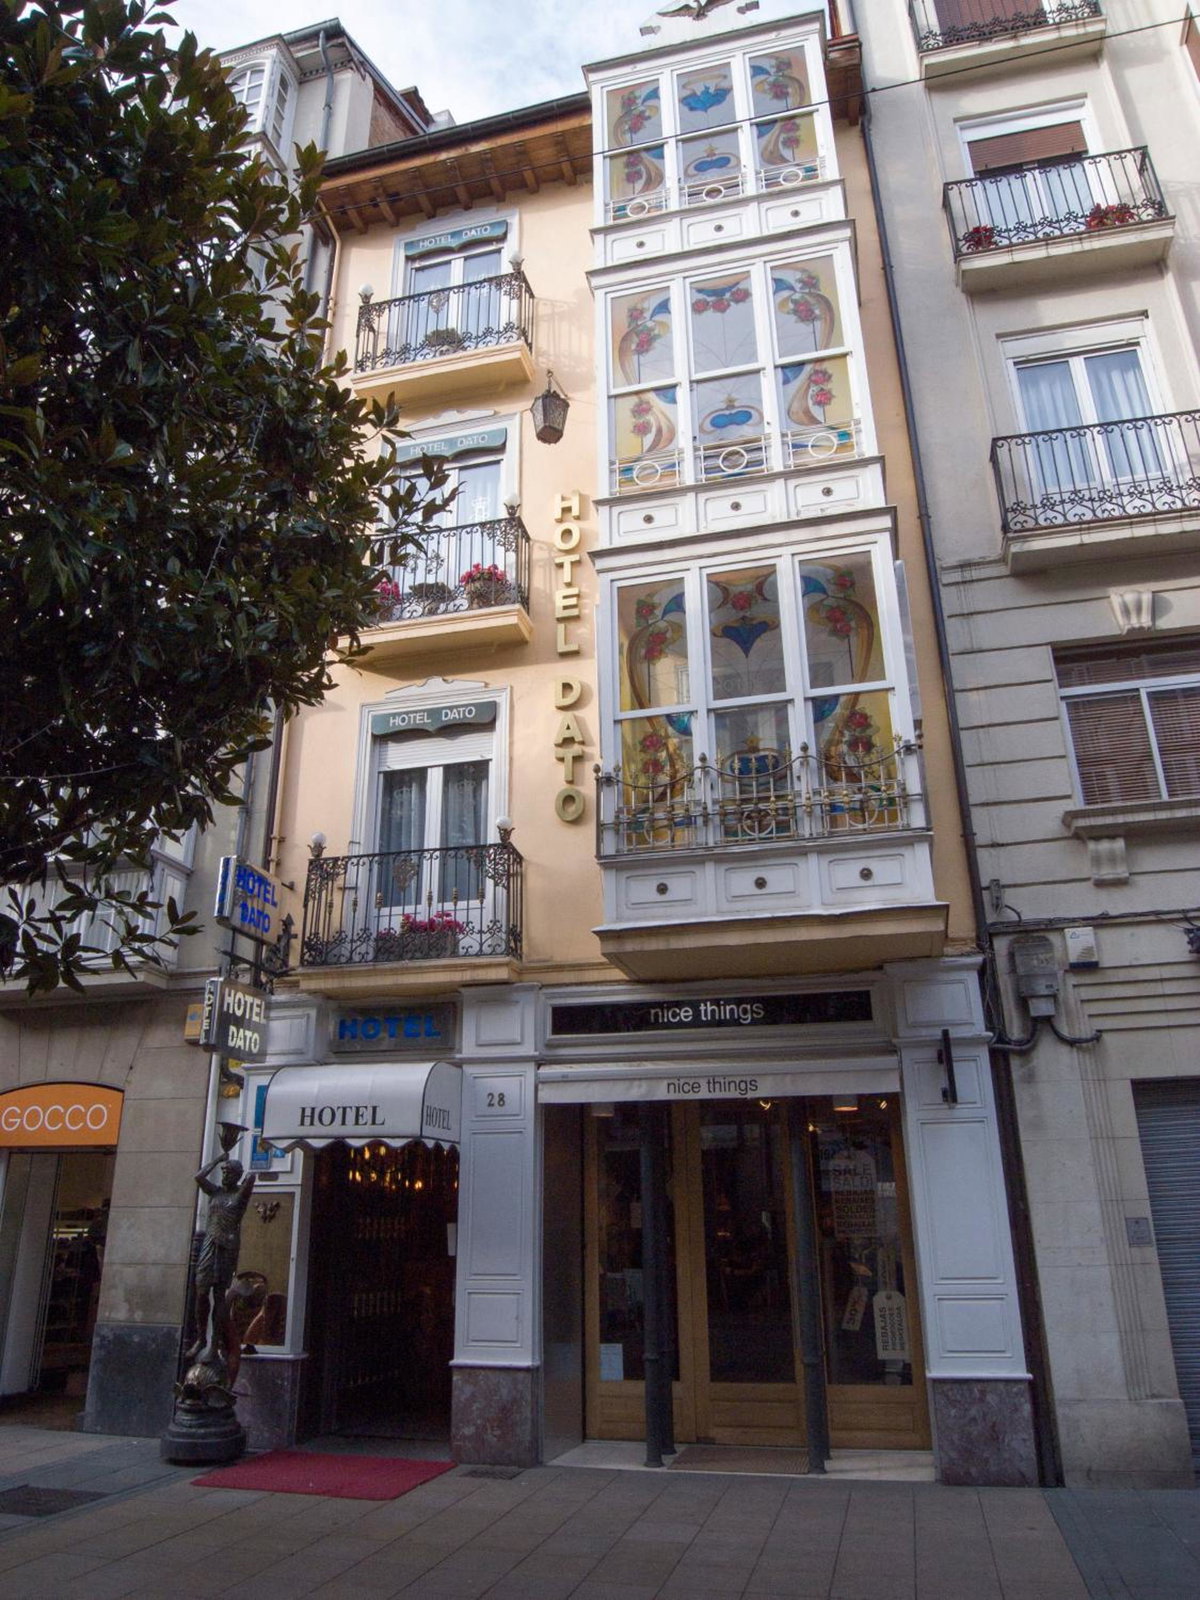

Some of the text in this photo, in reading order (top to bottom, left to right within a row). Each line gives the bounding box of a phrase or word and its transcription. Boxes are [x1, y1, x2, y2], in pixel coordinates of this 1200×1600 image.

[419, 225, 491, 249] HOTEL DATO
[409, 433, 488, 455] HOTEL DATO
[554, 490, 586, 823] HOTEL DATO
[389, 706, 476, 727] HOTEL DATO
[235, 863, 278, 908] HOTEL
[240, 901, 271, 933] DATO
[223, 987, 267, 1024] HOTEL
[649, 1001, 764, 1023] nice things
[228, 1024, 260, 1054] DATO
[338, 1014, 441, 1041] HOTEL
[486, 1092, 506, 1108] 28
[667, 1077, 758, 1095] nice things
[1, 1103, 108, 1132] GOCCO
[298, 1105, 386, 1128] HOTEL
[425, 1103, 453, 1132] HOTEL
[879, 1306, 890, 1351] REBAJAS
